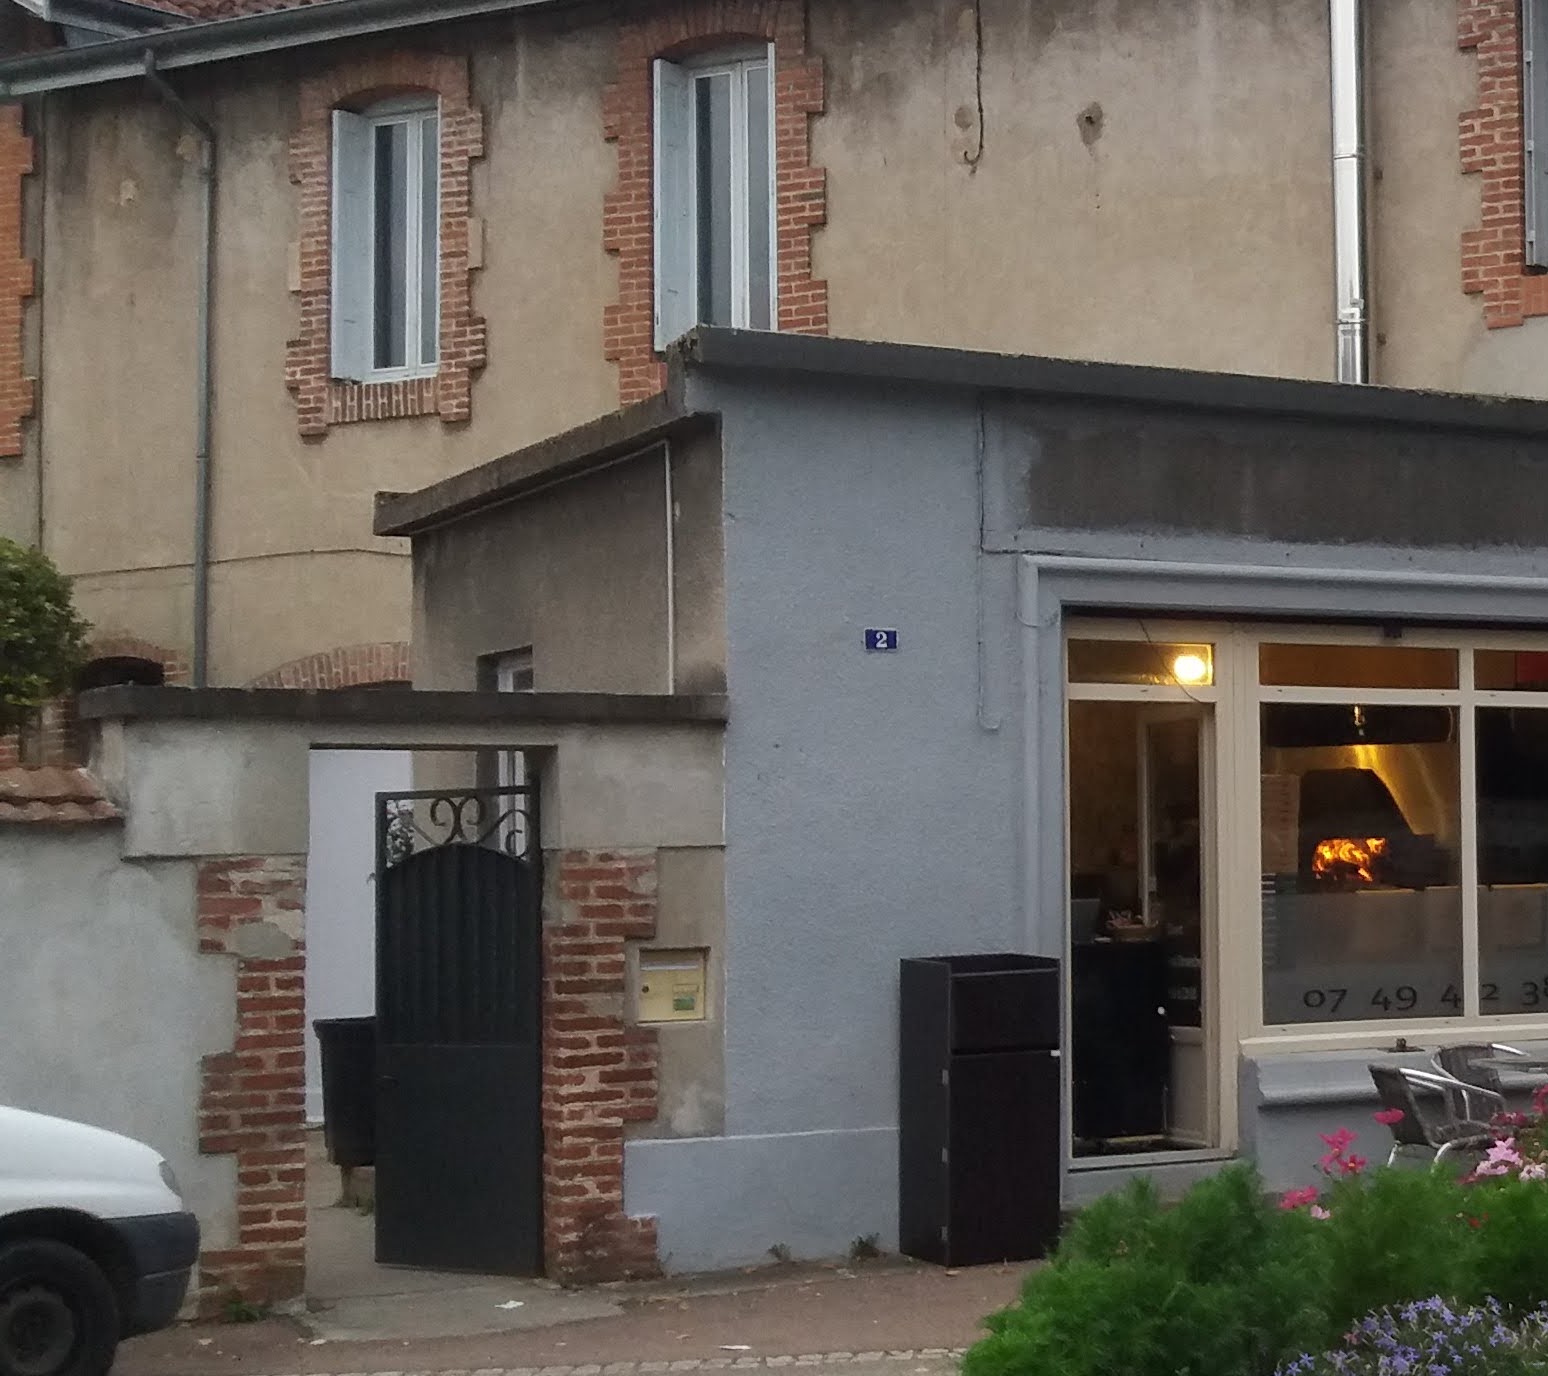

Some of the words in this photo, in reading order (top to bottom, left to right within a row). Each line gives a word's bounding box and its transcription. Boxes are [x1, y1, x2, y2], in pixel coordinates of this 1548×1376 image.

[875, 631, 888, 648] 2
[1303, 988, 1348, 1013] 07
[1370, 985, 1418, 1012] 49
